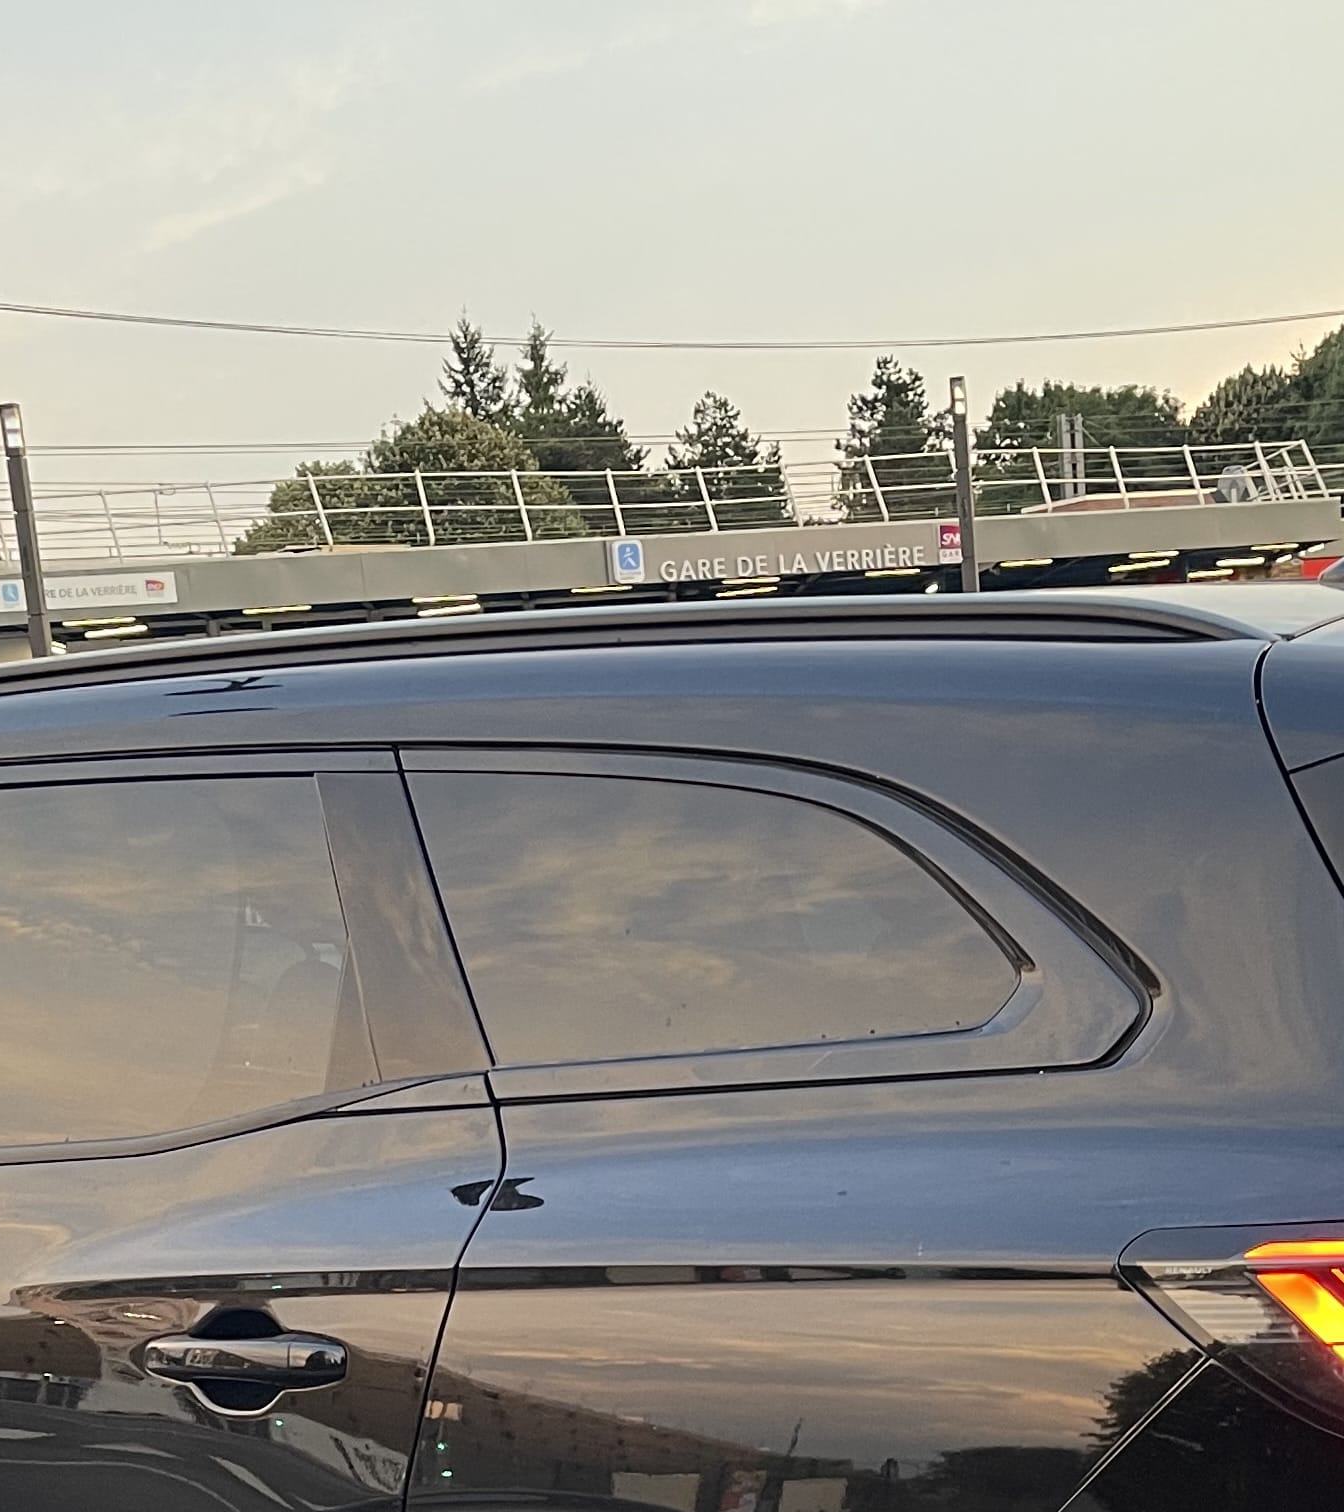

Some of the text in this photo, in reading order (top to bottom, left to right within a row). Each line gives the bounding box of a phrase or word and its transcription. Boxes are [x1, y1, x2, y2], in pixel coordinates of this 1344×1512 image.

[659, 544, 926, 582] GARE DE LA VERRIÈRE
[59, 587, 73, 598] DE
[76, 586, 89, 597] LA
